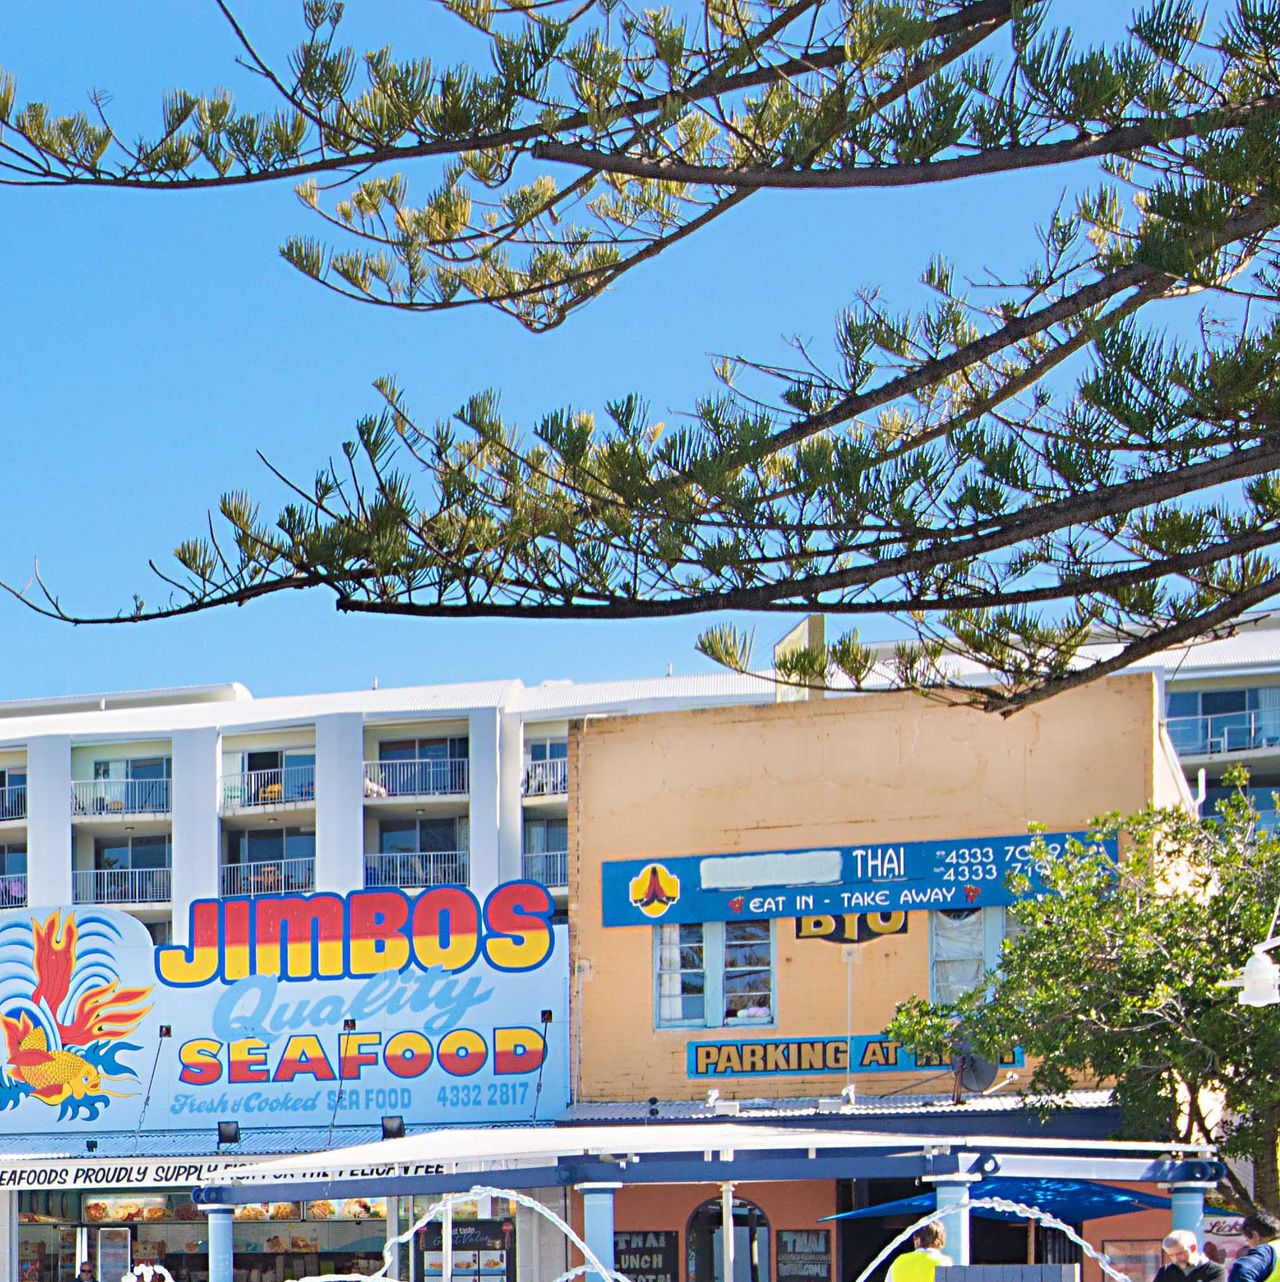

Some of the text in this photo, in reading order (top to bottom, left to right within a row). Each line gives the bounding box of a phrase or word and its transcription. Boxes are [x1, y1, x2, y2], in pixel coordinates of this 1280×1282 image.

[852, 847, 905, 879] THAI
[945, 843, 1061, 864] 4333 709
[943, 864, 997, 882] 4333
[749, 895, 785, 913] EAT
[796, 895, 814, 910] IN
[841, 890, 890, 909] TAKE
[900, 886, 956, 906] AWAY
[154, 879, 556, 988] JIMBOS
[211, 964, 496, 1044] Quality
[178, 1026, 548, 1086] SEAFOOD
[695, 1040, 849, 1075] PARKING
[859, 1040, 903, 1067] AT
[169, 1093, 230, 1115] Fresh
[243, 1091, 322, 1113] Cooked
[327, 1089, 360, 1111] SEA
[364, 1088, 412, 1110] FOOD
[436, 1084, 482, 1107] 4332
[487, 1082, 530, 1106] 2817
[73, 1165, 149, 1184] PROUDLY
[615, 1232, 666, 1249] THAI
